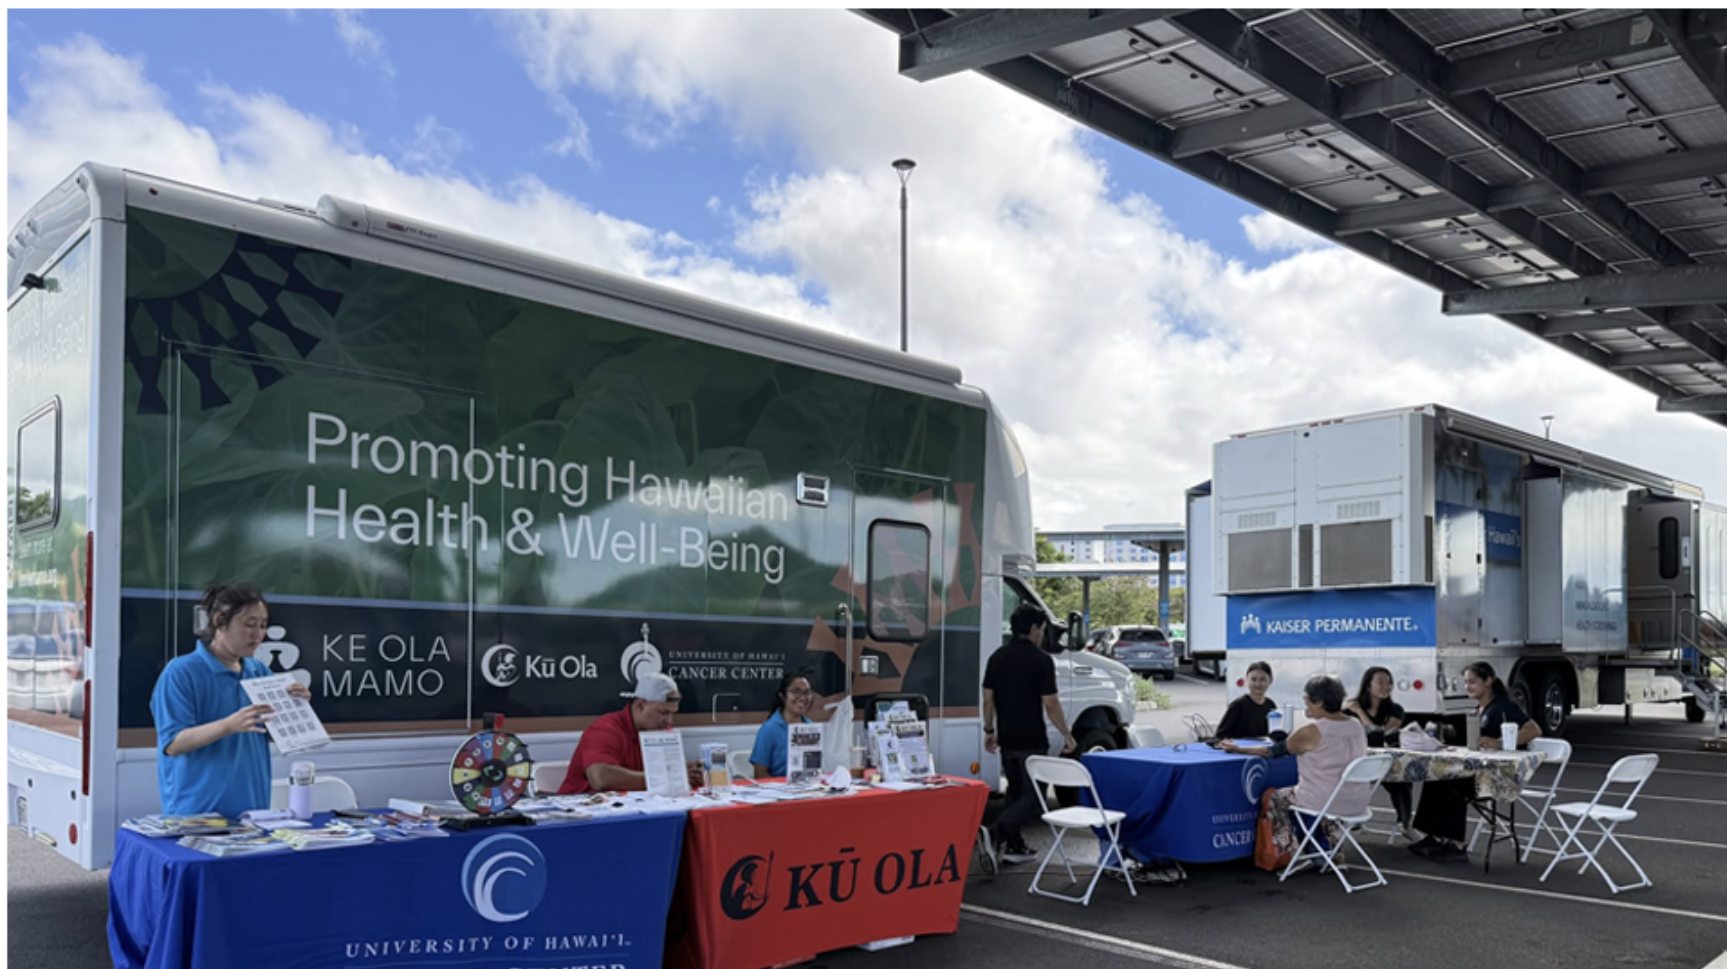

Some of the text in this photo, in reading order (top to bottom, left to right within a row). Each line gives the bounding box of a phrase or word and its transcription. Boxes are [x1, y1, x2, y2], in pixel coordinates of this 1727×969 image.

[306, 410, 789, 522] Promoting Hawaiian
[305, 484, 787, 585] Health & Well-Being
[1266, 618, 1311, 634] KAISER
[323, 633, 451, 663] KE OLA
[525, 654, 598, 679] Kū Ola
[668, 666, 784, 681] CANCER CENTER
[323, 668, 444, 698] MAMO
[783, 842, 961, 911] KŪ OLA
[345, 935, 494, 958] UNIVERSITY
[503, 935, 535, 951] OF
